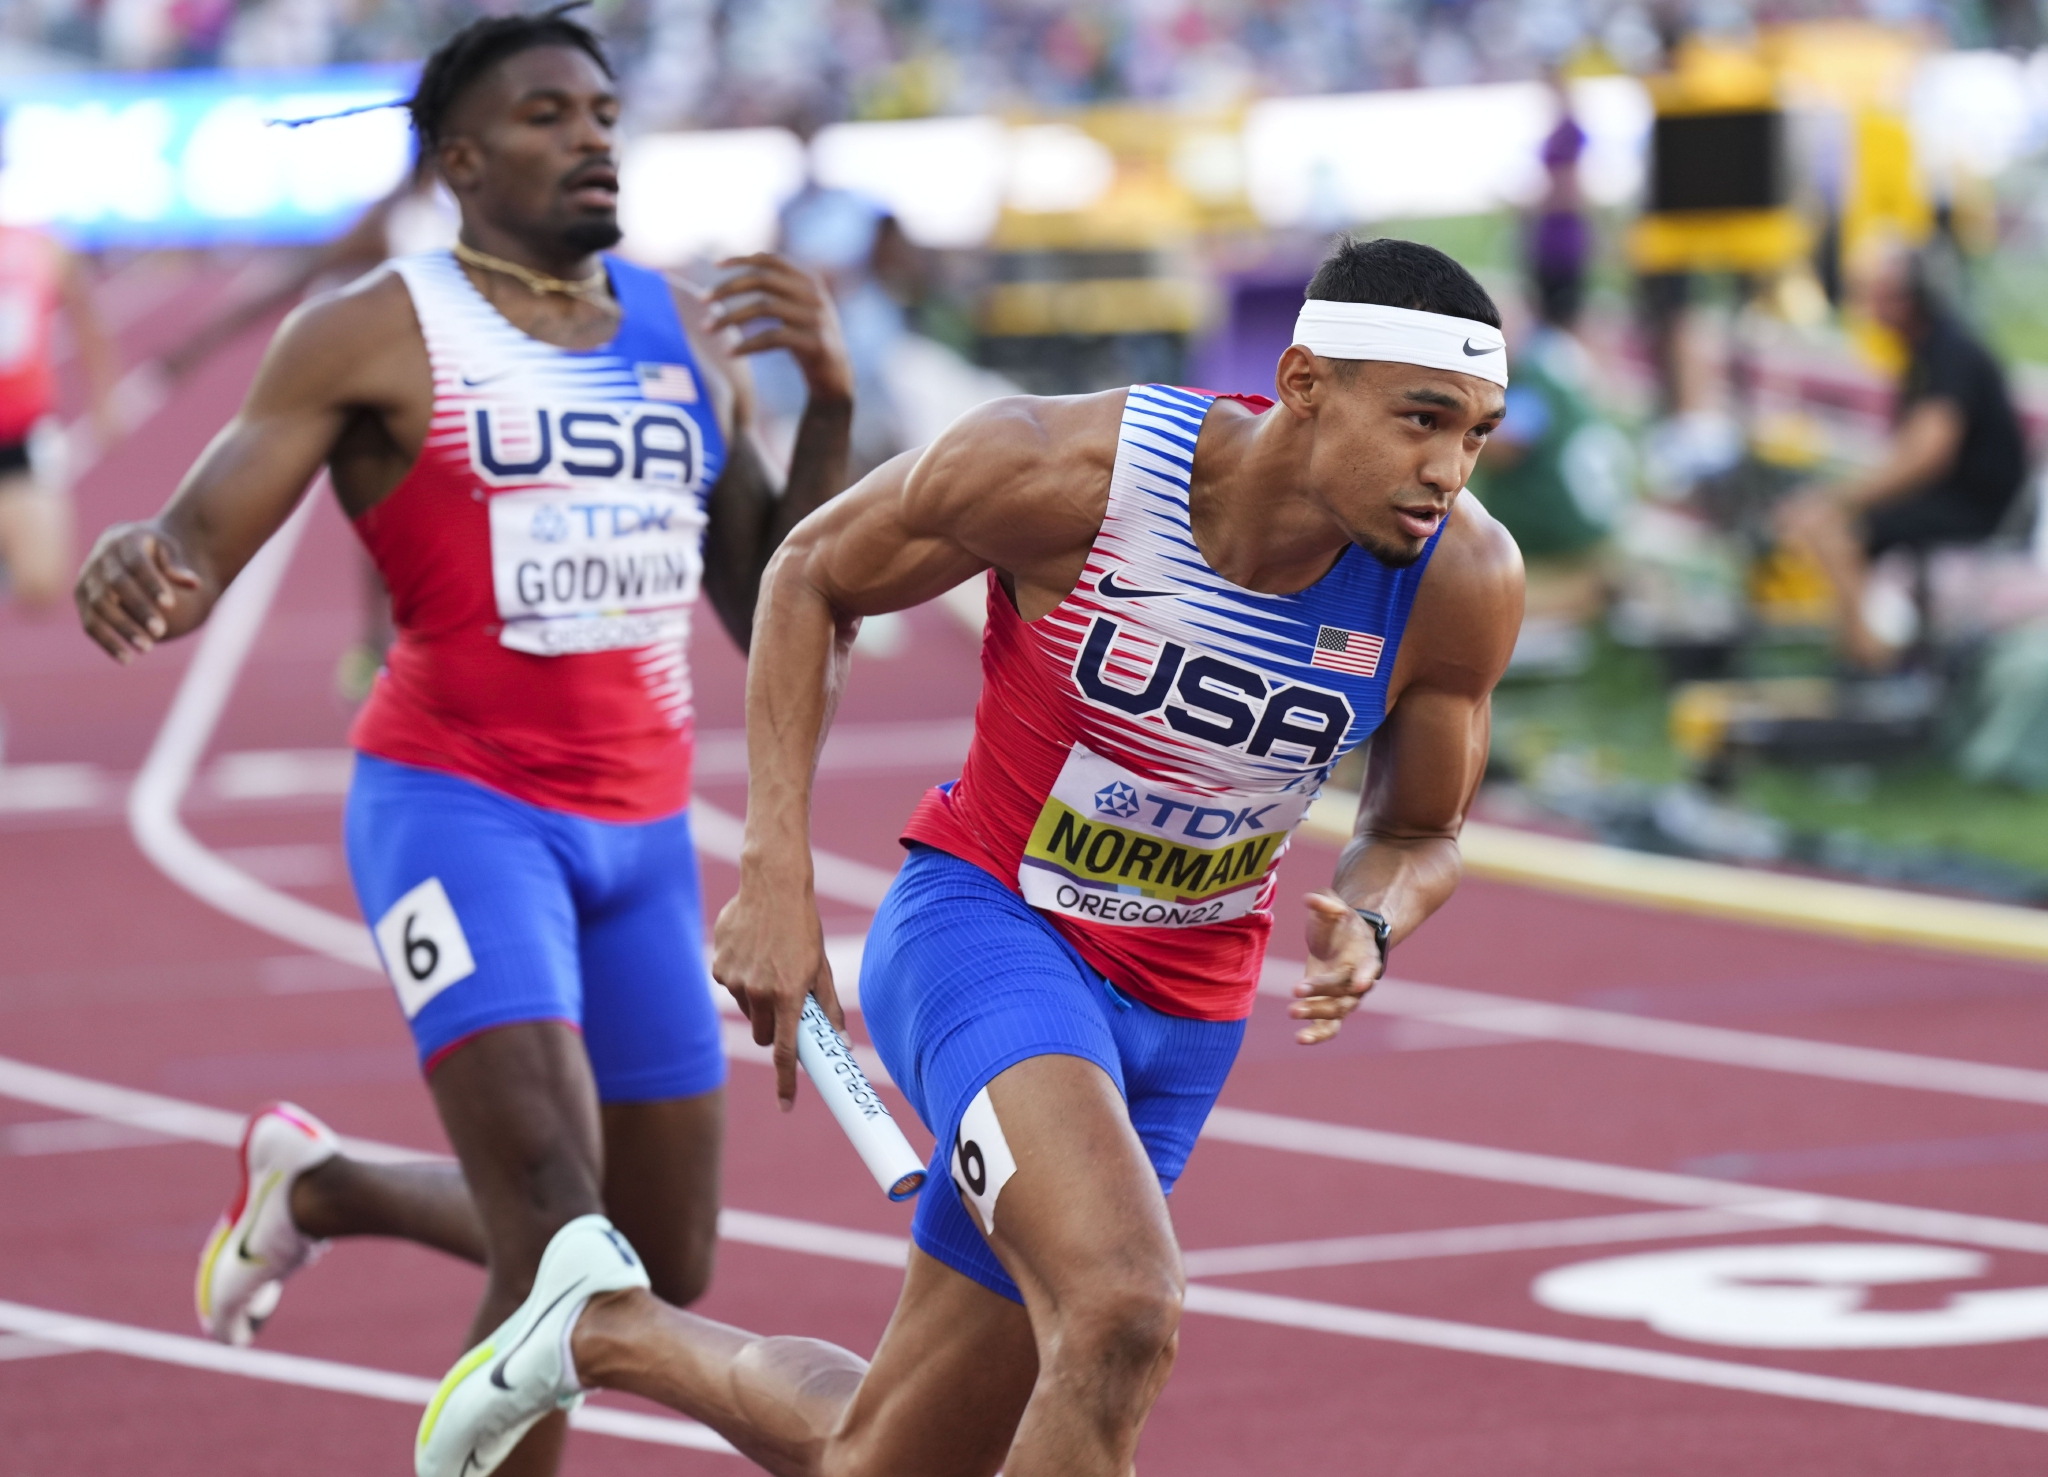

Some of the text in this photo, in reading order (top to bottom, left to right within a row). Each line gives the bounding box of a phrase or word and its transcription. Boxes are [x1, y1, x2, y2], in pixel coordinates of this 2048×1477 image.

[475, 408, 693, 484] USA
[568, 503, 674, 539] TDK
[516, 551, 687, 606] GODWIN
[1074, 615, 1354, 766] USA
[1046, 810, 1272, 892] NORMAN
[1144, 792, 1282, 841] TDK
[1056, 884, 1224, 925] OREGON22
[403, 911, 440, 982] 6
[800, 1004, 880, 1121] WORLD ATHLE
[956, 1122, 987, 1197] 6
